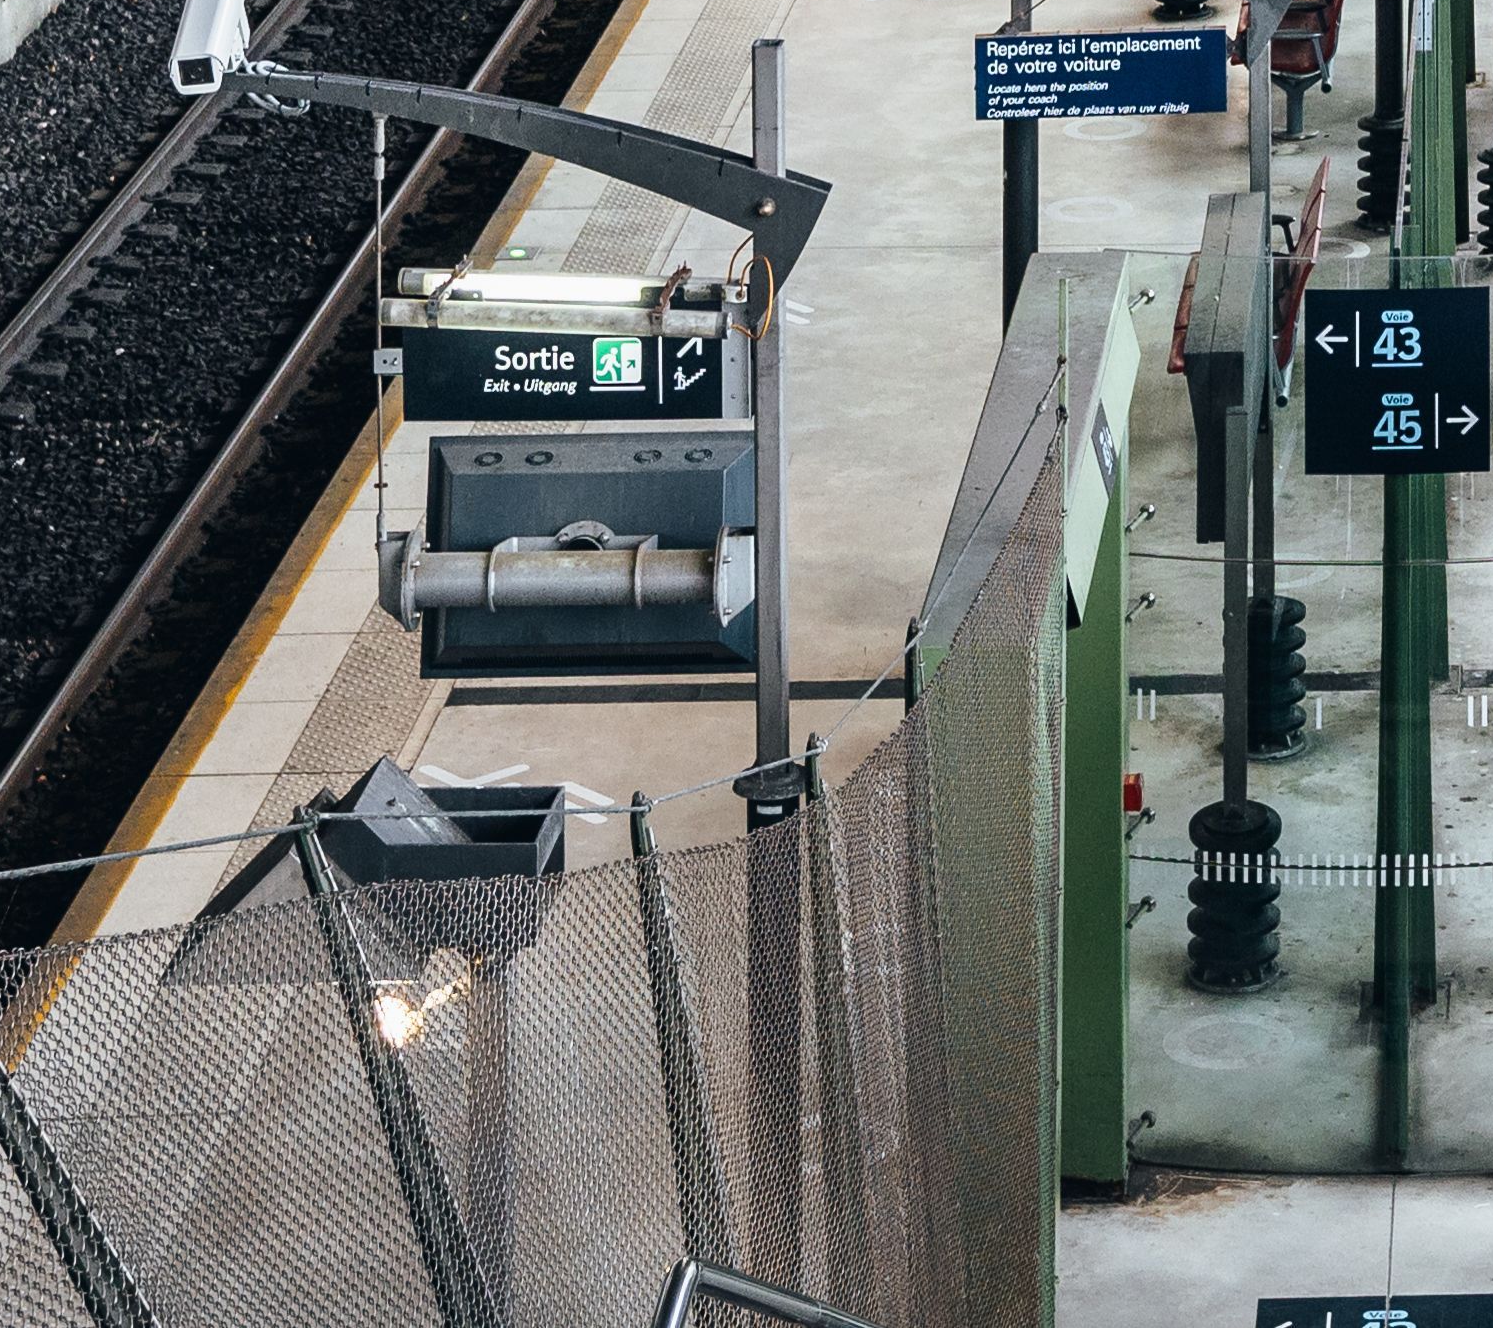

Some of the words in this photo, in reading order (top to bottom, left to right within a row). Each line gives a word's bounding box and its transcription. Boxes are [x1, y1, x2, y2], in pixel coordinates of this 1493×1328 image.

[986, 40, 1053, 59] Repérez
[1058, 39, 1076, 54] ici
[1081, 36, 1201, 57] l'emplacement
[987, 60, 1008, 75] de
[1015, 59, 1057, 74] votre
[1064, 57, 1121, 72] voiture
[988, 84, 1021, 94] Locate
[1024, 83, 1047, 93] here
[1050, 82, 1066, 92] the
[1068, 81, 1109, 93] position
[988, 95, 999, 105] of
[1002, 96, 1025, 107] your
[1028, 94, 1058, 104] coach
[986, 108, 1039, 118] Controleer
[1043, 106, 1064, 116] hier
[1067, 106, 1081, 116] de
[1083, 104, 1115, 117] plaats
[1117, 105, 1136, 114] van
[1139, 104, 1156, 113] uw
[1159, 102, 1190, 115] rijtuig
[1385, 312, 1410, 322] Voie
[1373, 326, 1422, 361] 43
[494, 345, 575, 371] Sortie
[484, 379, 510, 393] Exit
[523, 379, 577, 395] Uitgang
[1385, 395, 1410, 404] Voie
[1373, 409, 1422, 444] 45
